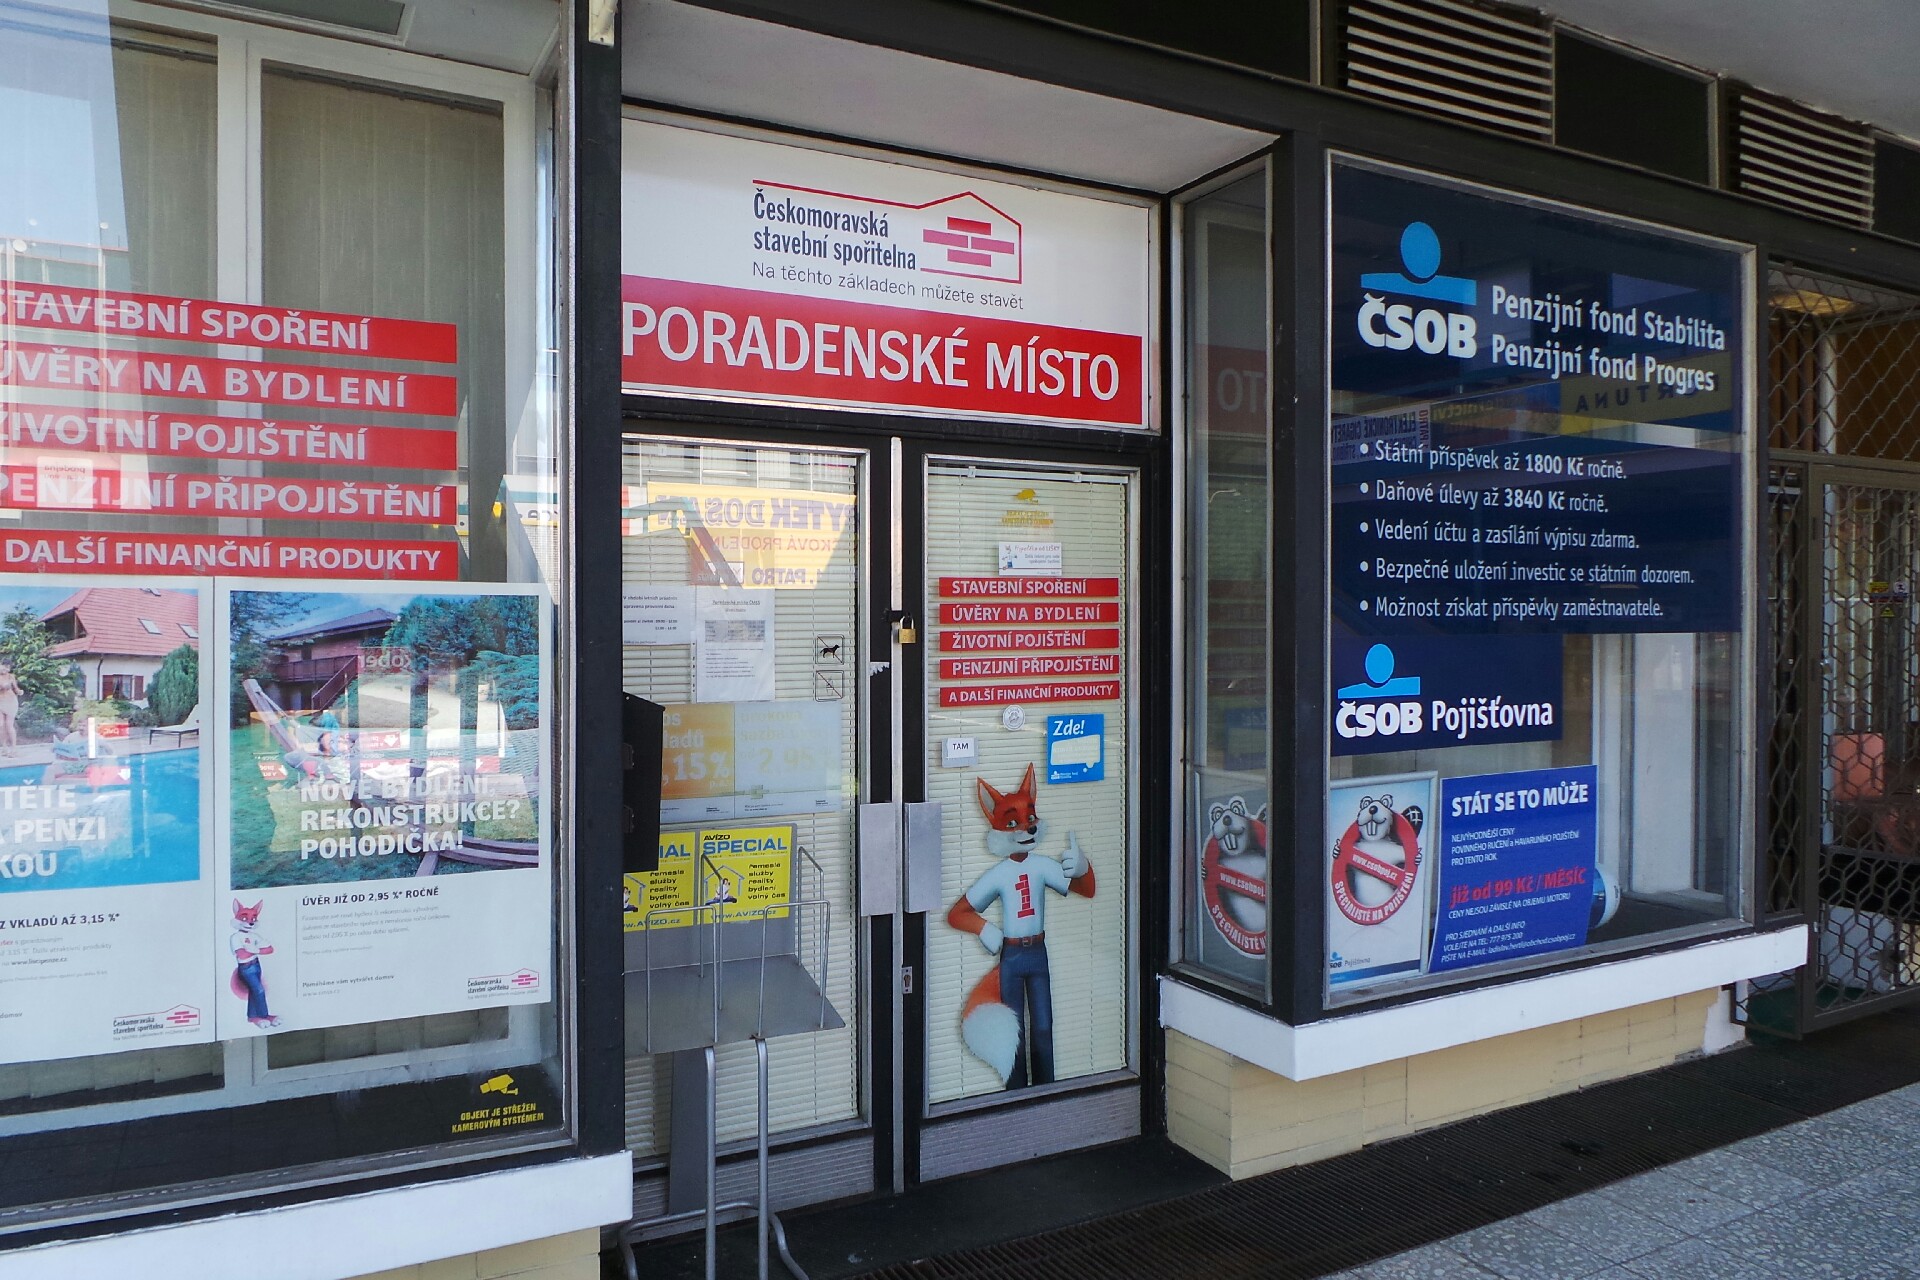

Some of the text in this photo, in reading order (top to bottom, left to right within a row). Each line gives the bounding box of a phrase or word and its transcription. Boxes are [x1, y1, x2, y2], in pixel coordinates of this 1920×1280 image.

[754, 188, 888, 238] Českomoravská
[753, 226, 916, 271] stavební spořitelna
[752, 262, 1024, 310] Na těchto základech můžete stavět
[201, 309, 371, 351] SPOŘENÍ
[1357, 293, 1477, 360] ČSOB
[1492, 285, 1726, 351] Penzijní fond Stabilita
[622, 301, 1119, 401] PORADENSKÉ MÍSTO
[1492, 334, 1715, 395] Penzijní fond Progres
[144, 362, 207, 394] NA
[225, 367, 406, 407] BYDLENÍ
[170, 420, 366, 461] POJIŠTĚNÍ
[1375, 440, 1424, 466] Státní
[1430, 446, 1499, 473] příspěvek
[1504, 452, 1520, 472] až
[1525, 453, 1562, 476] 1800
[1567, 456, 1584, 477] Kč
[1587, 459, 1627, 480] ročně.
[188, 475, 442, 519] PŘIPOJIŠTĚNÍ
[1376, 480, 1609, 514] Daňové úlevy až 3840 Kč ročně.
[1375, 518, 1640, 551] Vedení účtu a zasílání výpisu zdarma.
[6, 535, 441, 572] DALŠÍ FINANČNÍ PRODUKTY
[952, 579, 1087, 594] STAVEBNÍ SPOŘENÍ
[1376, 557, 1695, 585] Bezpečné uložení investic se státním dozorem.
[952, 604, 1100, 621] ÚVĚRY NA BYDLENÍ
[1376, 596, 1664, 622] Možnost získat příspěvky zaměstnavatele.
[952, 630, 1086, 649] ŽIVOTNÍ POJIŠTĚNÍ
[952, 655, 1114, 675] PENZIJNÍ PŘIPOJIŠTĚNÍ
[949, 684, 1114, 703] A DALŠÍ FINANČNÍ PRODUKTY
[1053, 718, 1085, 736] Zde!
[1335, 695, 1553, 740] ČSOB Pojišťovna
[952, 743, 969, 751] TAM
[301, 799, 521, 832] REKONSTRUKCE?
[1451, 781, 1588, 817] STÁT SE TO MŮŽE
[14, 816, 106, 844] PENZI
[301, 828, 464, 860] POHODIČKA!
[703, 835, 788, 855] SPECIÁL
[1451, 854, 1484, 867] PRO TENTO
[302, 894, 331, 906] ÚVĚR
[333, 892, 349, 904] JIŽ
[350, 893, 366, 902] OD
[368, 891, 390, 903] 2,95
[405, 886, 440, 899] ROČNĚ
[1372, 909, 1384, 921] NA
[1384, 872, 1415, 916] POJIŠTĚNÍ
[1450, 884, 1470, 908] již
[1472, 880, 1491, 899] od
[1494, 878, 1513, 897] 99
[1515, 874, 1534, 893] Kč
[1543, 865, 1587, 889] MĚSÍC
[9, 914, 58, 929] VKLADŮ
[61, 912, 77, 926] AŽ
[80, 913, 105, 925] 3,15
[1448, 909, 1465, 920] CENY
[1465, 905, 1489, 917] NEJSOU
[1512, 900, 1522, 908] NA
[1445, 932, 1459, 942] PRO
[1510, 920, 1526, 930] INFO
[452, 1112, 544, 1133] KAMEROVÝM SYSTÉMEM
[461, 1102, 537, 1121] OBJEKT JE STŘEŽEN
